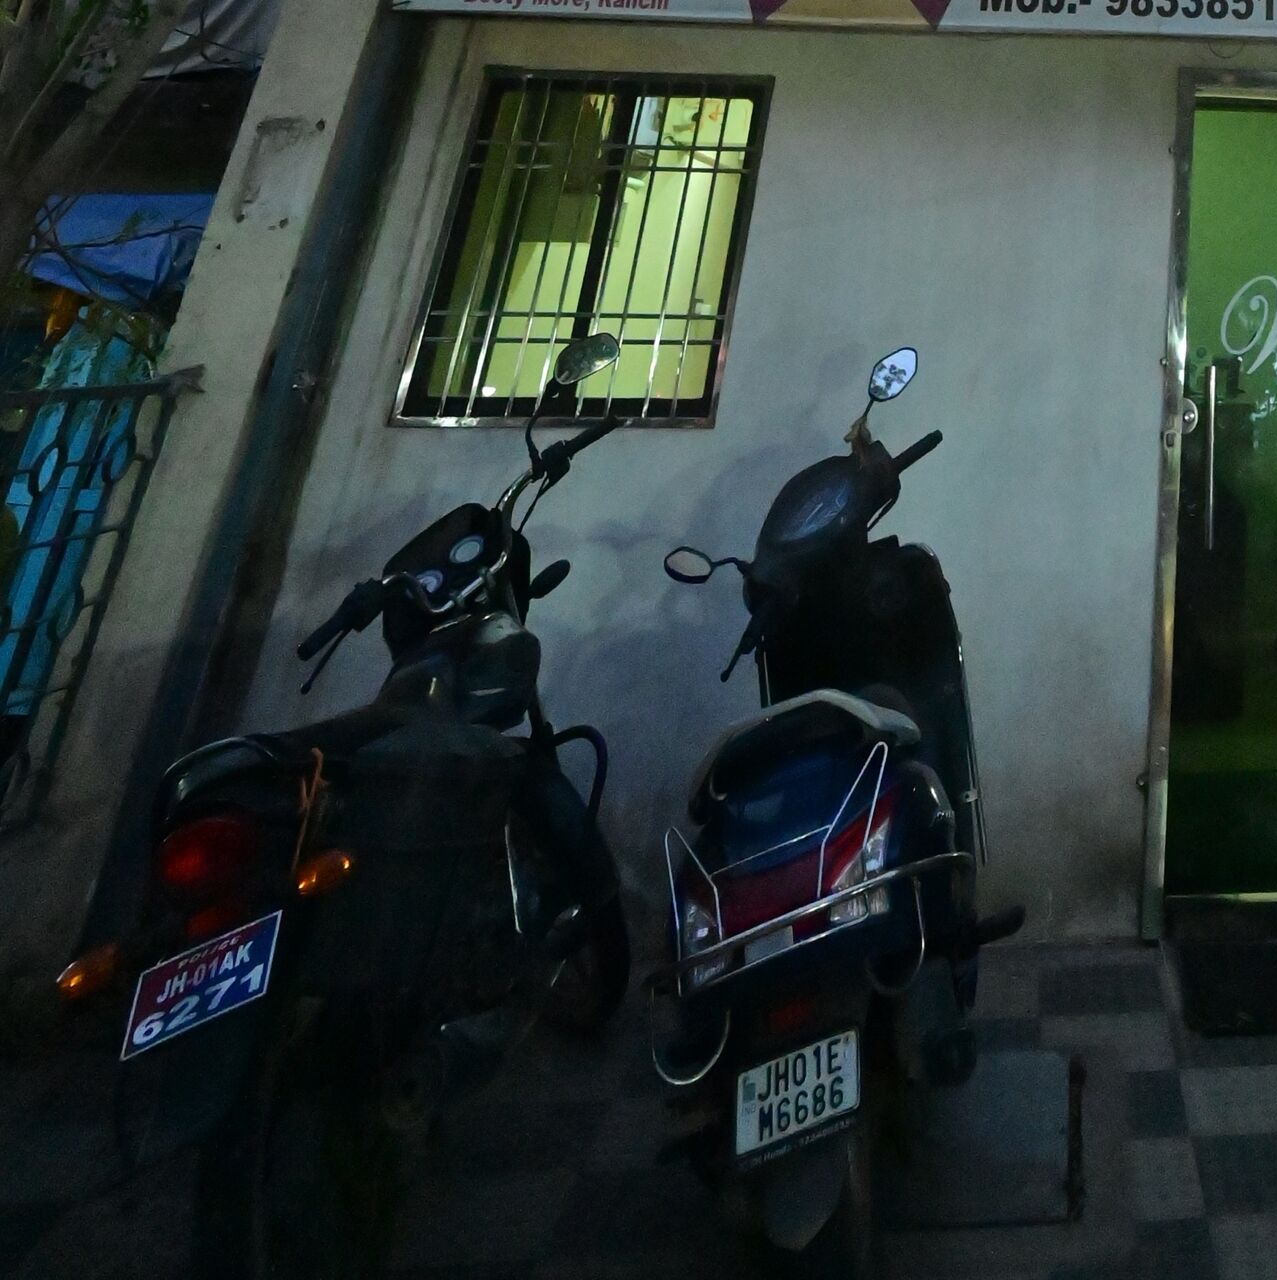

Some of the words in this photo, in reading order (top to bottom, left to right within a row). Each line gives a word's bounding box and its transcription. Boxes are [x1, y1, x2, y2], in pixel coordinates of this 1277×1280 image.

[132, 963, 265, 1045] 6271
[758, 1038, 842, 1102] JH01E
[759, 1077, 844, 1142] M6686
